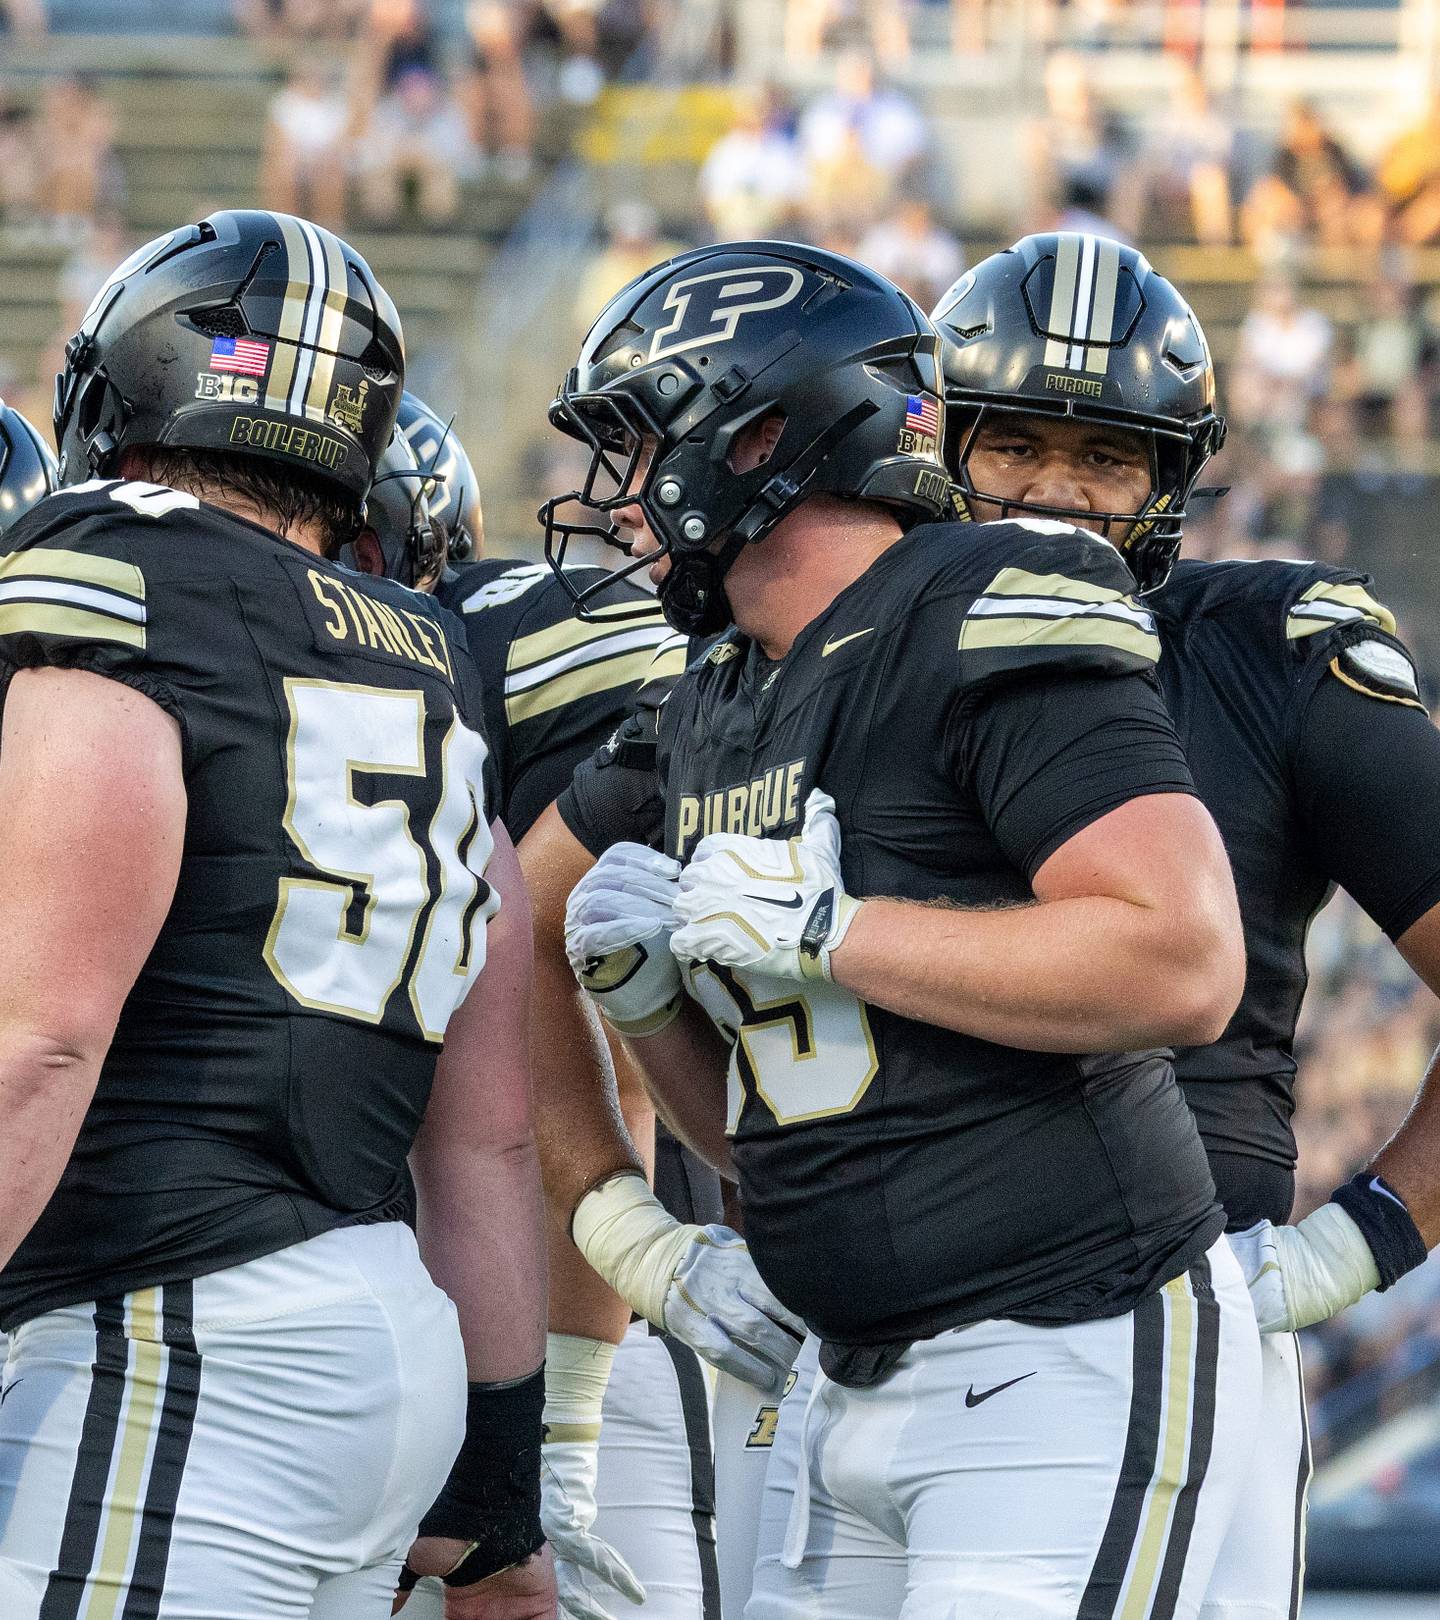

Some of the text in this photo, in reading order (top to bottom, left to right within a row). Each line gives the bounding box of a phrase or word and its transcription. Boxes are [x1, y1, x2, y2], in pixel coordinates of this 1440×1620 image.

[647, 265, 804, 363] P
[1046, 373, 1103, 399] PURDUE
[229, 415, 349, 471] BOILER UP
[677, 757, 806, 857] PURDUE
[262, 677, 502, 1043] 50
